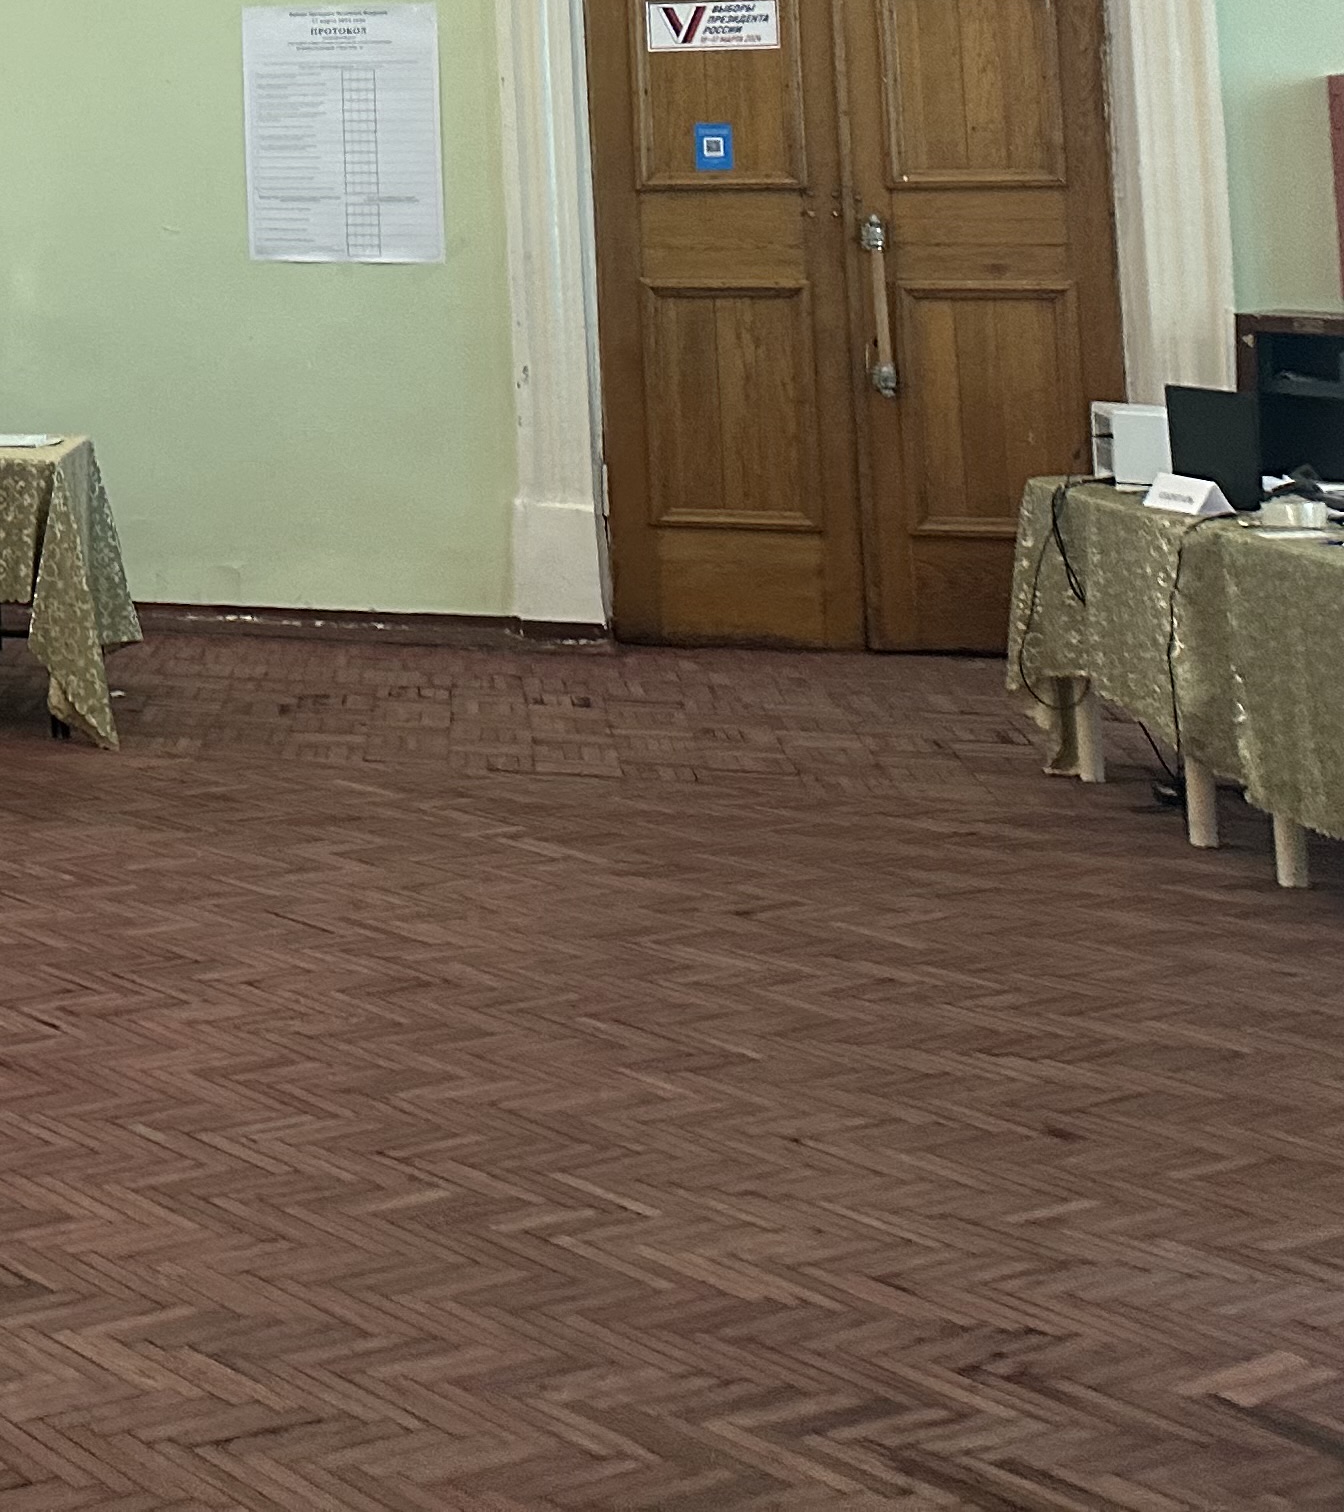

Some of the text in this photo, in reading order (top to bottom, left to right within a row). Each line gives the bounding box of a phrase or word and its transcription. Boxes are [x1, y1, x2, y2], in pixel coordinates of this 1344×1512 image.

[712, 4, 756, 14] ВЫБОРЫ
[707, 14, 770, 25] ПРЕЗИДЕНТА
[311, 28, 367, 36] ПРОТОКОЛ
[703, 26, 743, 35] РОССИИ
